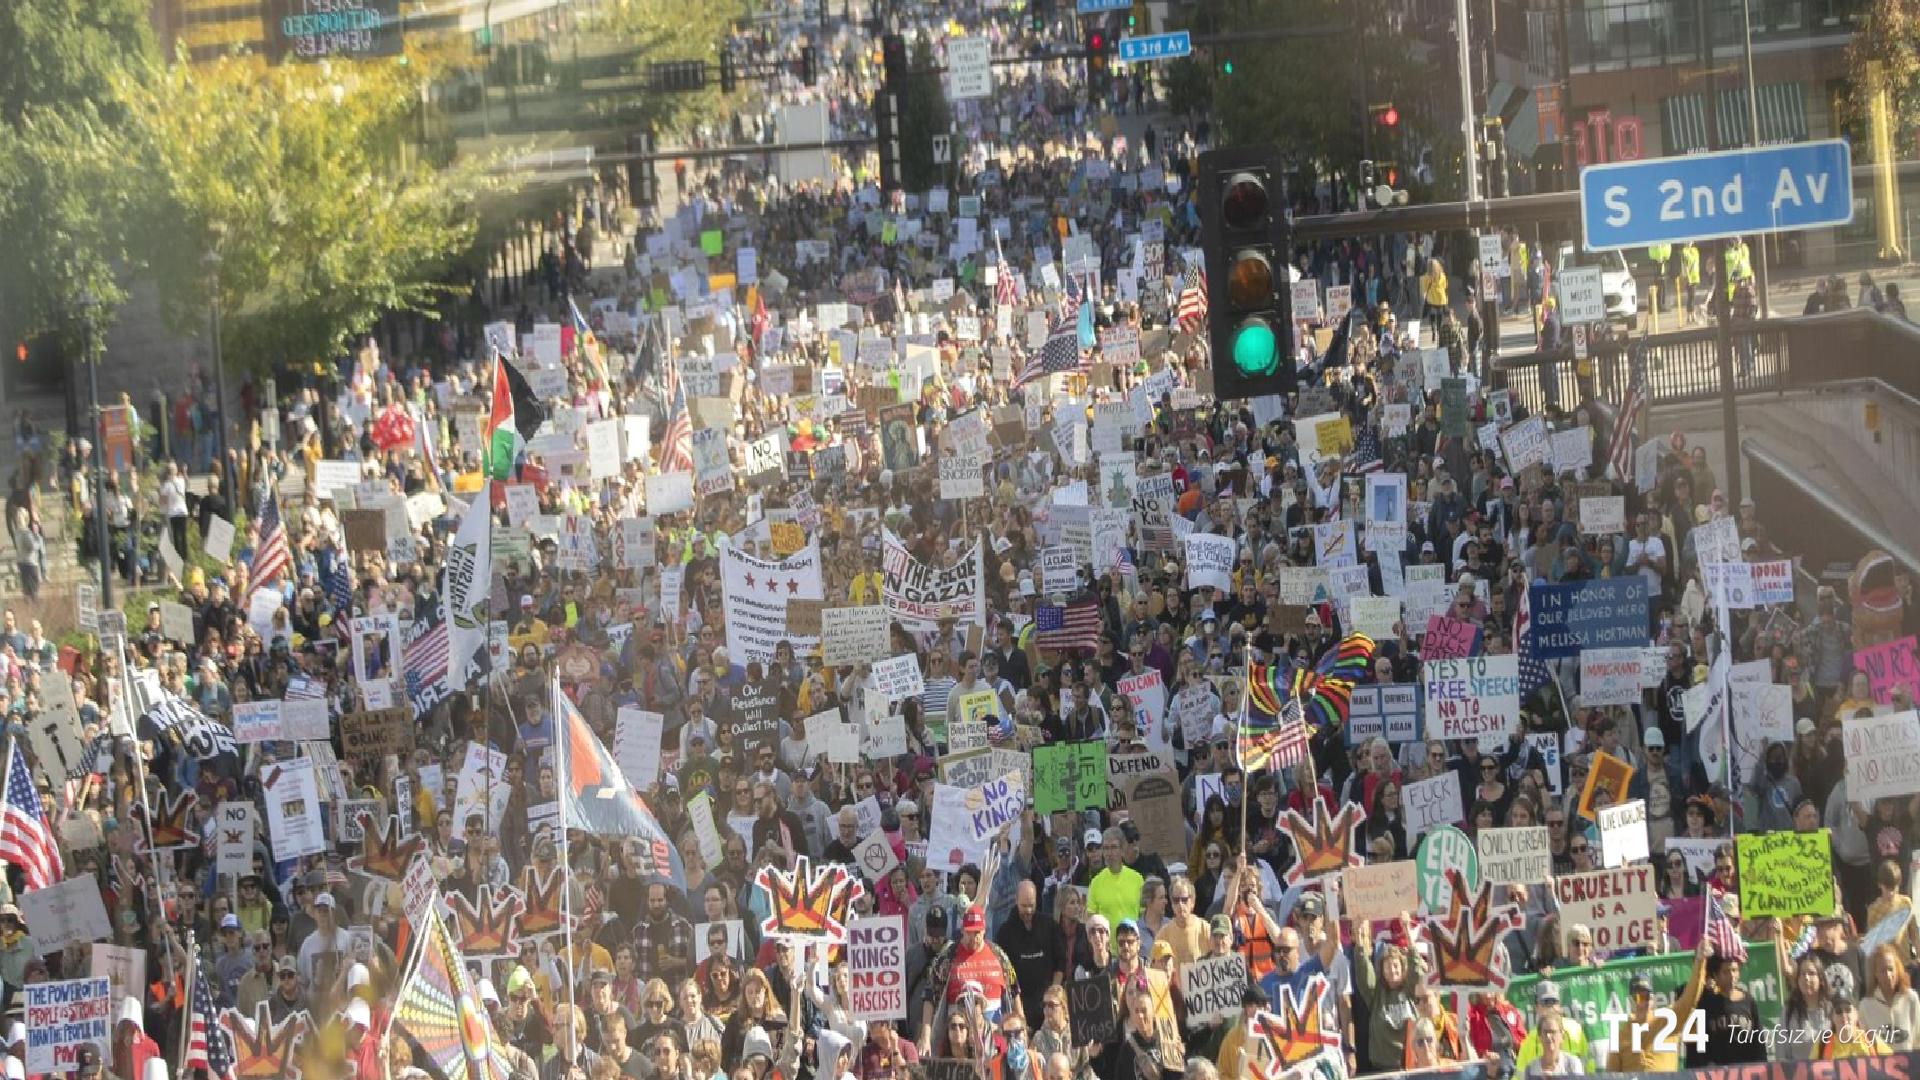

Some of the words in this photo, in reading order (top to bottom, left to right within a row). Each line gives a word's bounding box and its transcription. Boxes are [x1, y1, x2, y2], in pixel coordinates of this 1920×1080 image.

[1142, 42, 1162, 55] 3rd
[1168, 38, 1184, 52] Av
[1605, 187, 1631, 227] S
[1659, 173, 1743, 221] 2nd
[1773, 167, 1829, 209] Av
[1570, 289, 1593, 302] MUST
[753, 440, 771, 458] NO
[904, 578, 976, 604] GAZA!
[1542, 592, 1562, 609] IN
[1571, 586, 1616, 605] HONOR
[1626, 584, 1644, 599] OF
[897, 599, 976, 616] PALESINE!
[1538, 612, 1564, 626] OUR
[1568, 606, 1612, 624] BELOVED
[1617, 603, 1647, 618] HERO
[1437, 617, 1464, 634] NO
[1538, 630, 1591, 649] MELISSA
[1595, 625, 1648, 642] HORTMAN
[1428, 661, 1459, 681] YES
[1467, 659, 1487, 677] TO
[742, 684, 762, 697] Our
[1117, 679, 1136, 695] YOU
[1428, 680, 1466, 700] FREE
[1470, 676, 1519, 699] SPEECH
[731, 696, 777, 711] Resistance
[1352, 694, 1373, 706] MAKE
[1384, 692, 1414, 704] ORWELL
[1438, 700, 1457, 720] NO
[1463, 697, 1481, 717] TO
[1354, 722, 1383, 735] FICTION
[1389, 720, 1412, 732] AGAIN
[1109, 755, 1160, 775] DEFEND
[952, 770, 991, 788] PEOPL
[982, 779, 1008, 807] NO
[1409, 778, 1451, 807] FUCK
[225, 808, 246, 821] NO
[972, 789, 1025, 840] KINGS
[1416, 800, 1450, 828] ICE
[1481, 832, 1514, 857] ONLY
[1517, 829, 1547, 850] GREAT
[1560, 868, 1649, 905] CRUELTY
[1592, 903, 1606, 919] IS
[1614, 901, 1627, 915] A
[850, 927, 899, 945] NO
[1590, 919, 1655, 948] OICE
[851, 946, 900, 970] KINGS
[852, 971, 900, 989] NO
[1189, 966, 1209, 991] NO
[1209, 957, 1245, 985] KINGS
[28, 986, 48, 1001] THE
[47, 982, 82, 1000] POWER
[82, 981, 90, 997] OF
[90, 978, 109, 995] THE
[1071, 983, 1101, 1014] NO
[853, 990, 901, 1014] FASCISTS
[1185, 994, 1205, 1017] NO
[29, 1006, 59, 1028] PEOPLE
[28, 1029, 49, 1048] THAN
[63, 1022, 91, 1042] PEOPLE
[93, 1019, 107, 1038] IN
[54, 1044, 81, 1067] POW
